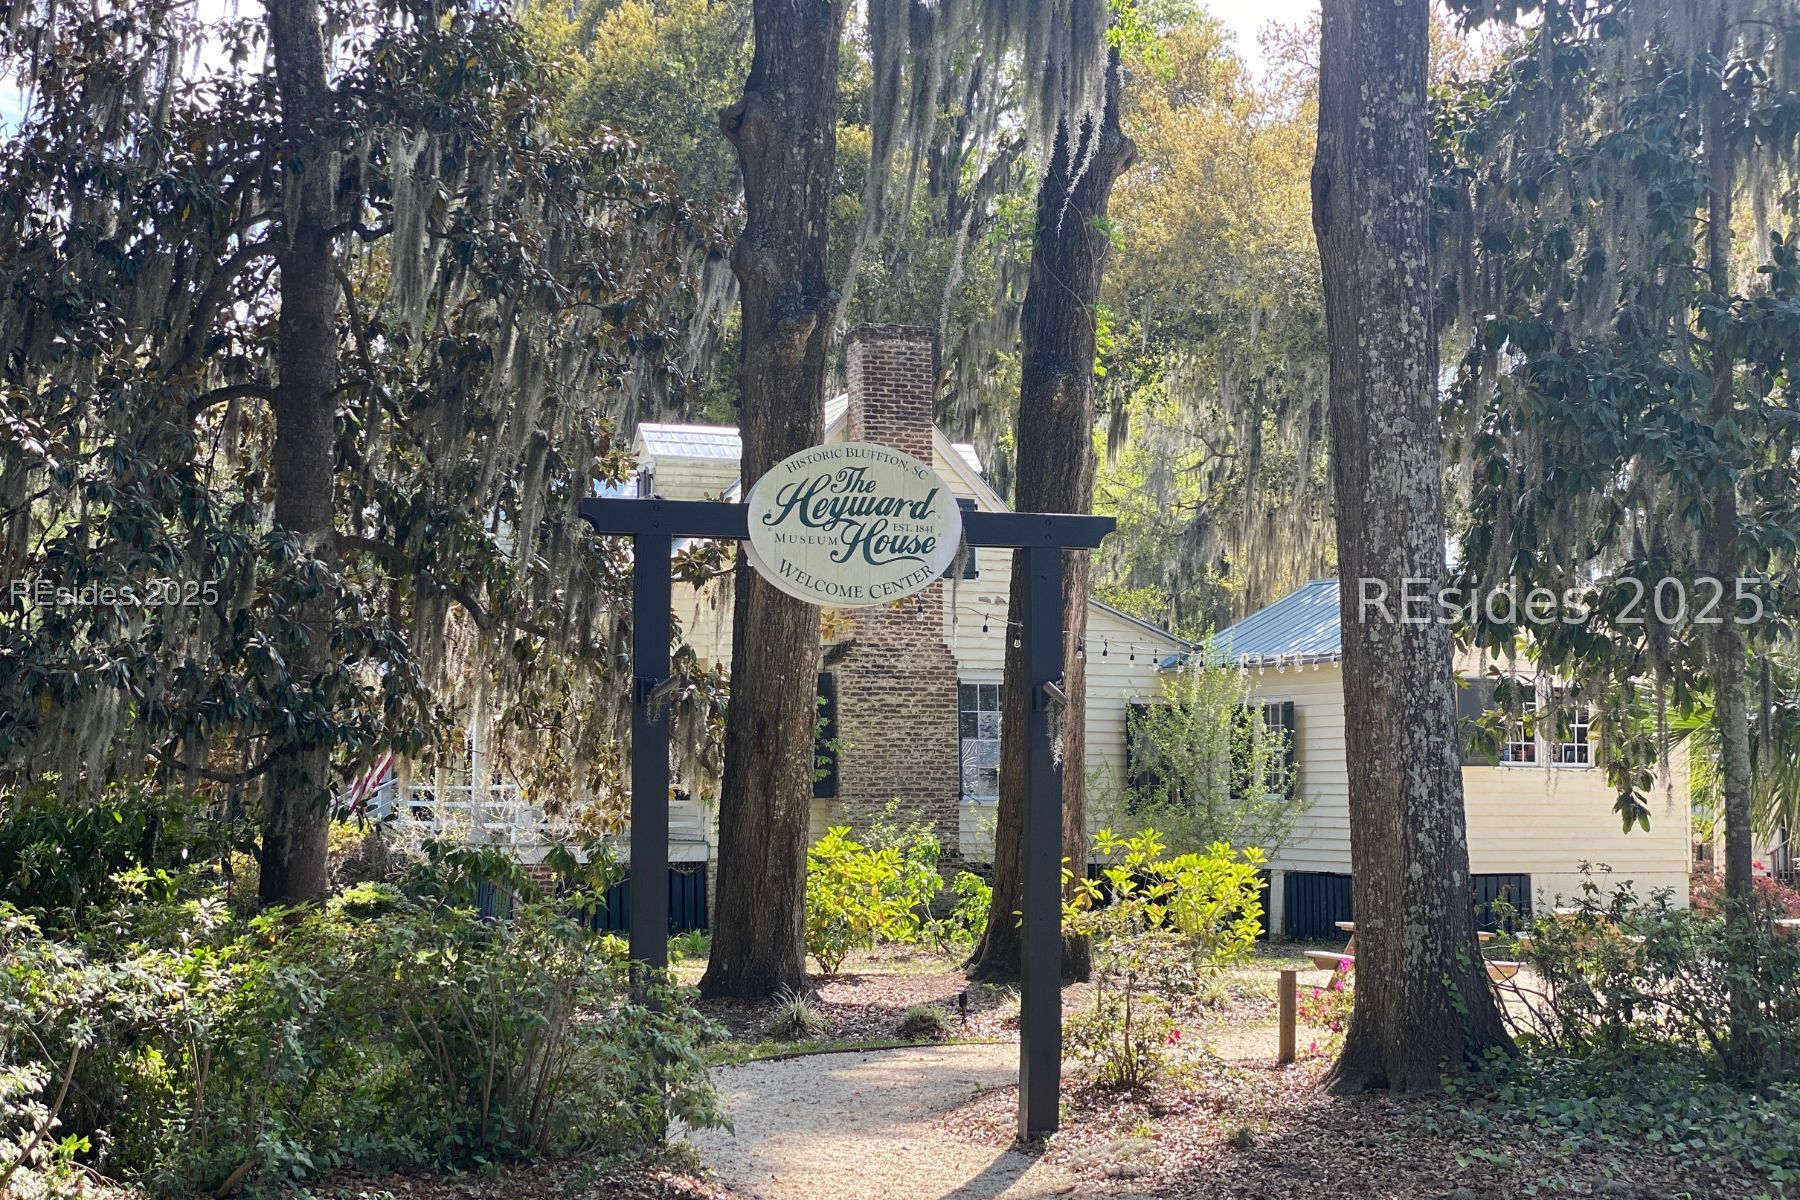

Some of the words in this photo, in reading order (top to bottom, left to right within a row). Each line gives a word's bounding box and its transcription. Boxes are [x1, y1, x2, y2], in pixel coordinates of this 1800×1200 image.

[785, 448, 842, 473] HISTORIC
[846, 447, 909, 472] BLUFFTON,
[911, 466, 929, 480] SC
[830, 466, 876, 493] The
[762, 473, 940, 531] Heyward
[774, 533, 838, 545] MUSEUM
[830, 518, 937, 565] House
[893, 523, 913, 532] EST.
[916, 525, 933, 533] 1841
[779, 558, 864, 599] WELCOME
[869, 565, 935, 599] CENTER
